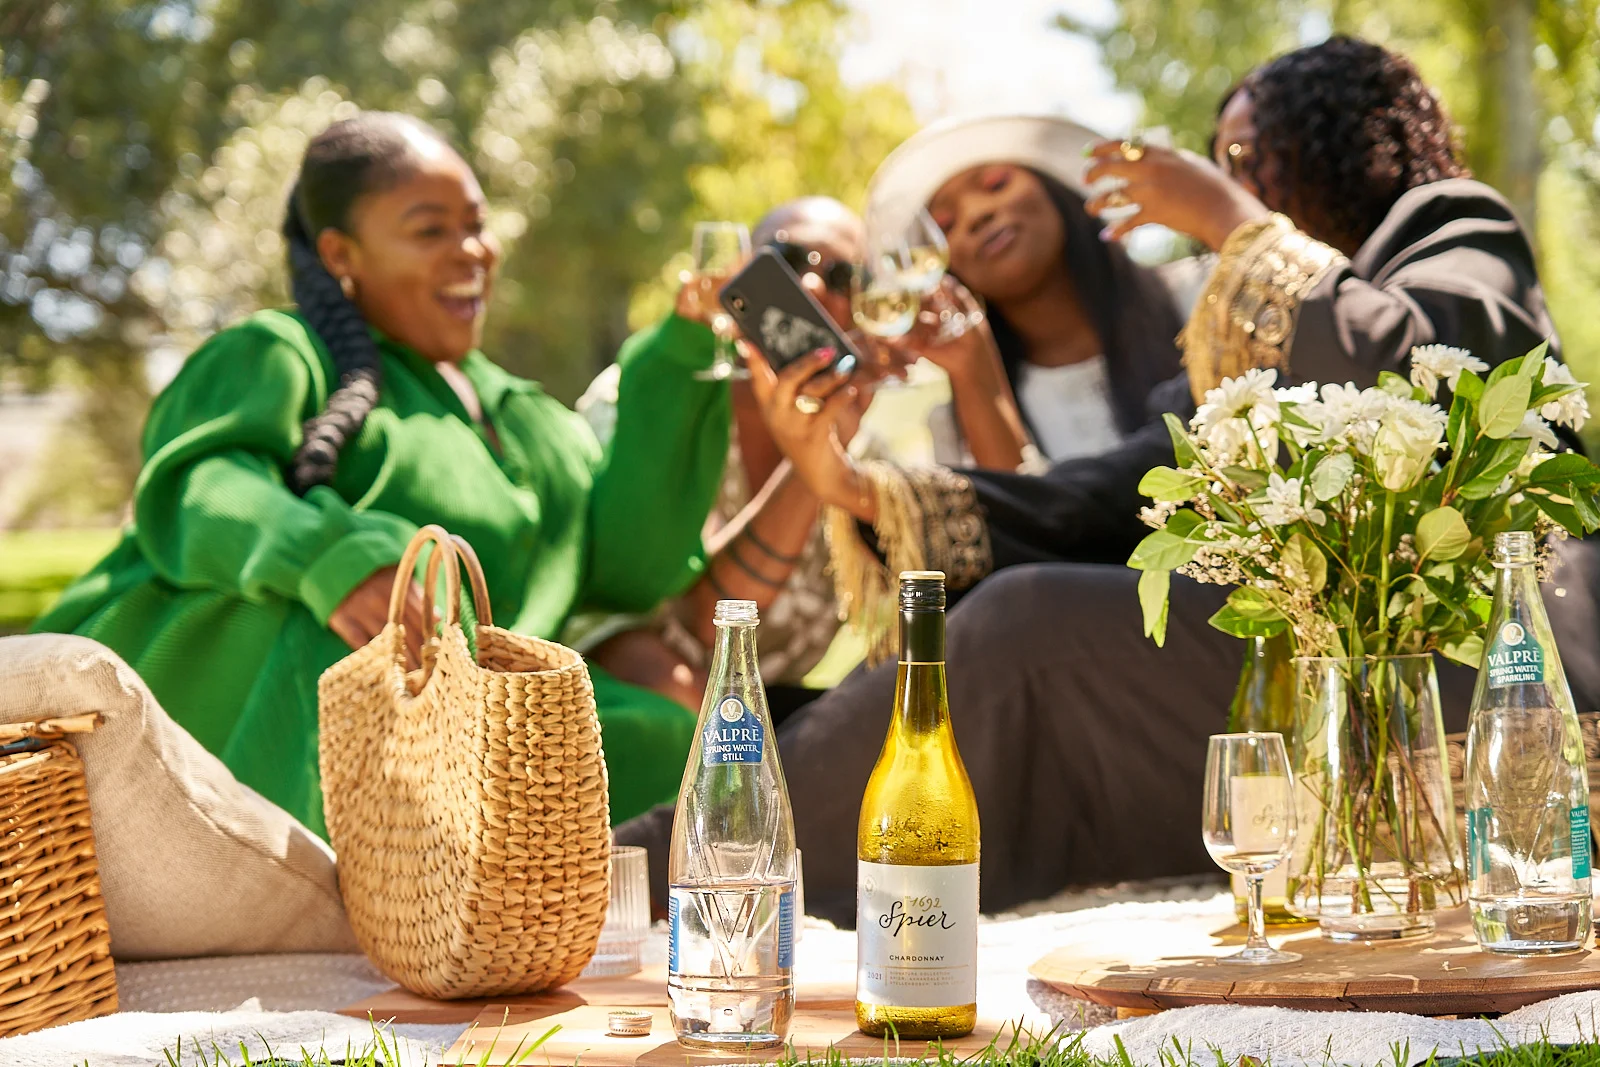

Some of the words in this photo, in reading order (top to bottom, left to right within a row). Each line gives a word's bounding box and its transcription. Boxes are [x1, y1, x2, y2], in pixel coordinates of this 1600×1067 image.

[1490, 667, 1513, 677] SPRING
[1514, 665, 1542, 674] WATER
[1496, 673, 1536, 683] SPARKLING
[705, 744, 731, 754] SPRING
[732, 744, 761, 754] WATER
[722, 753, 744, 761] STILL
[909, 896, 942, 912] 1692
[879, 900, 956, 937] Spier
[867, 972, 882, 980] 2021
